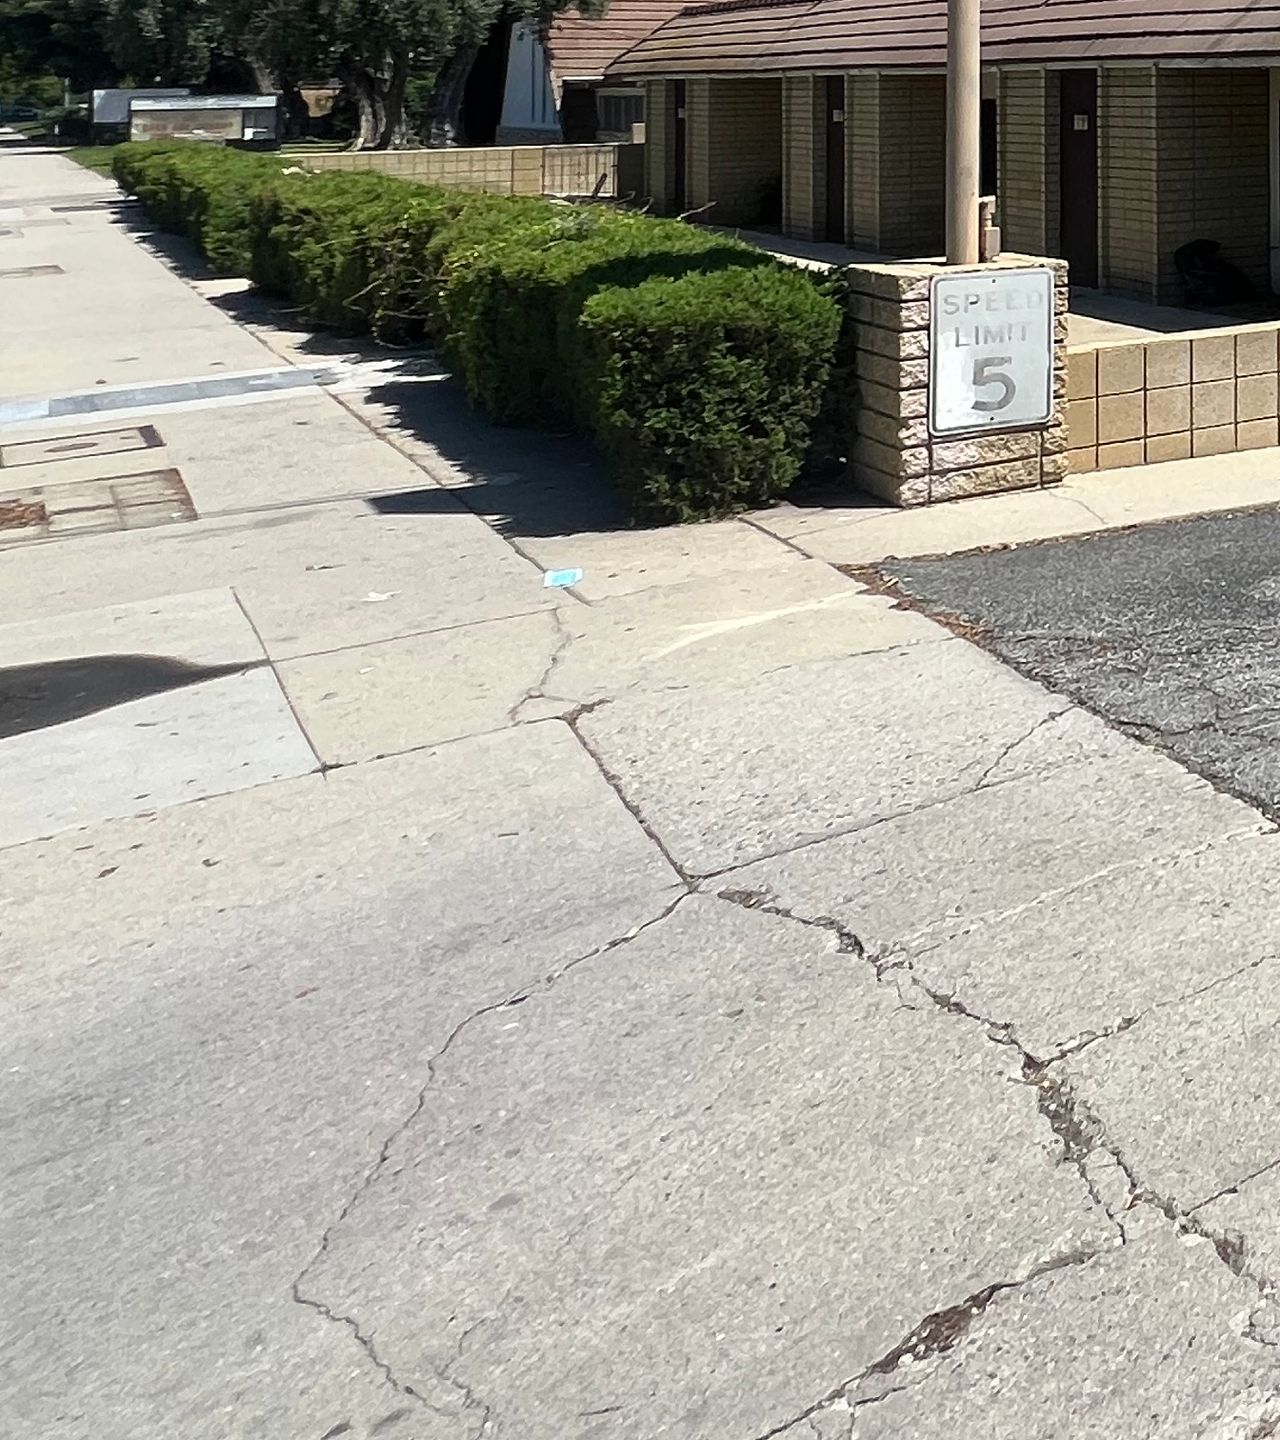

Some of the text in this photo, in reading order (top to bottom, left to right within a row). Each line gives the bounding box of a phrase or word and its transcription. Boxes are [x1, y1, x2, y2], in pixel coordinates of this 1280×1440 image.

[944, 291, 1043, 315] SPEED
[955, 323, 1030, 347] LIMIT
[972, 356, 1016, 411] 5
